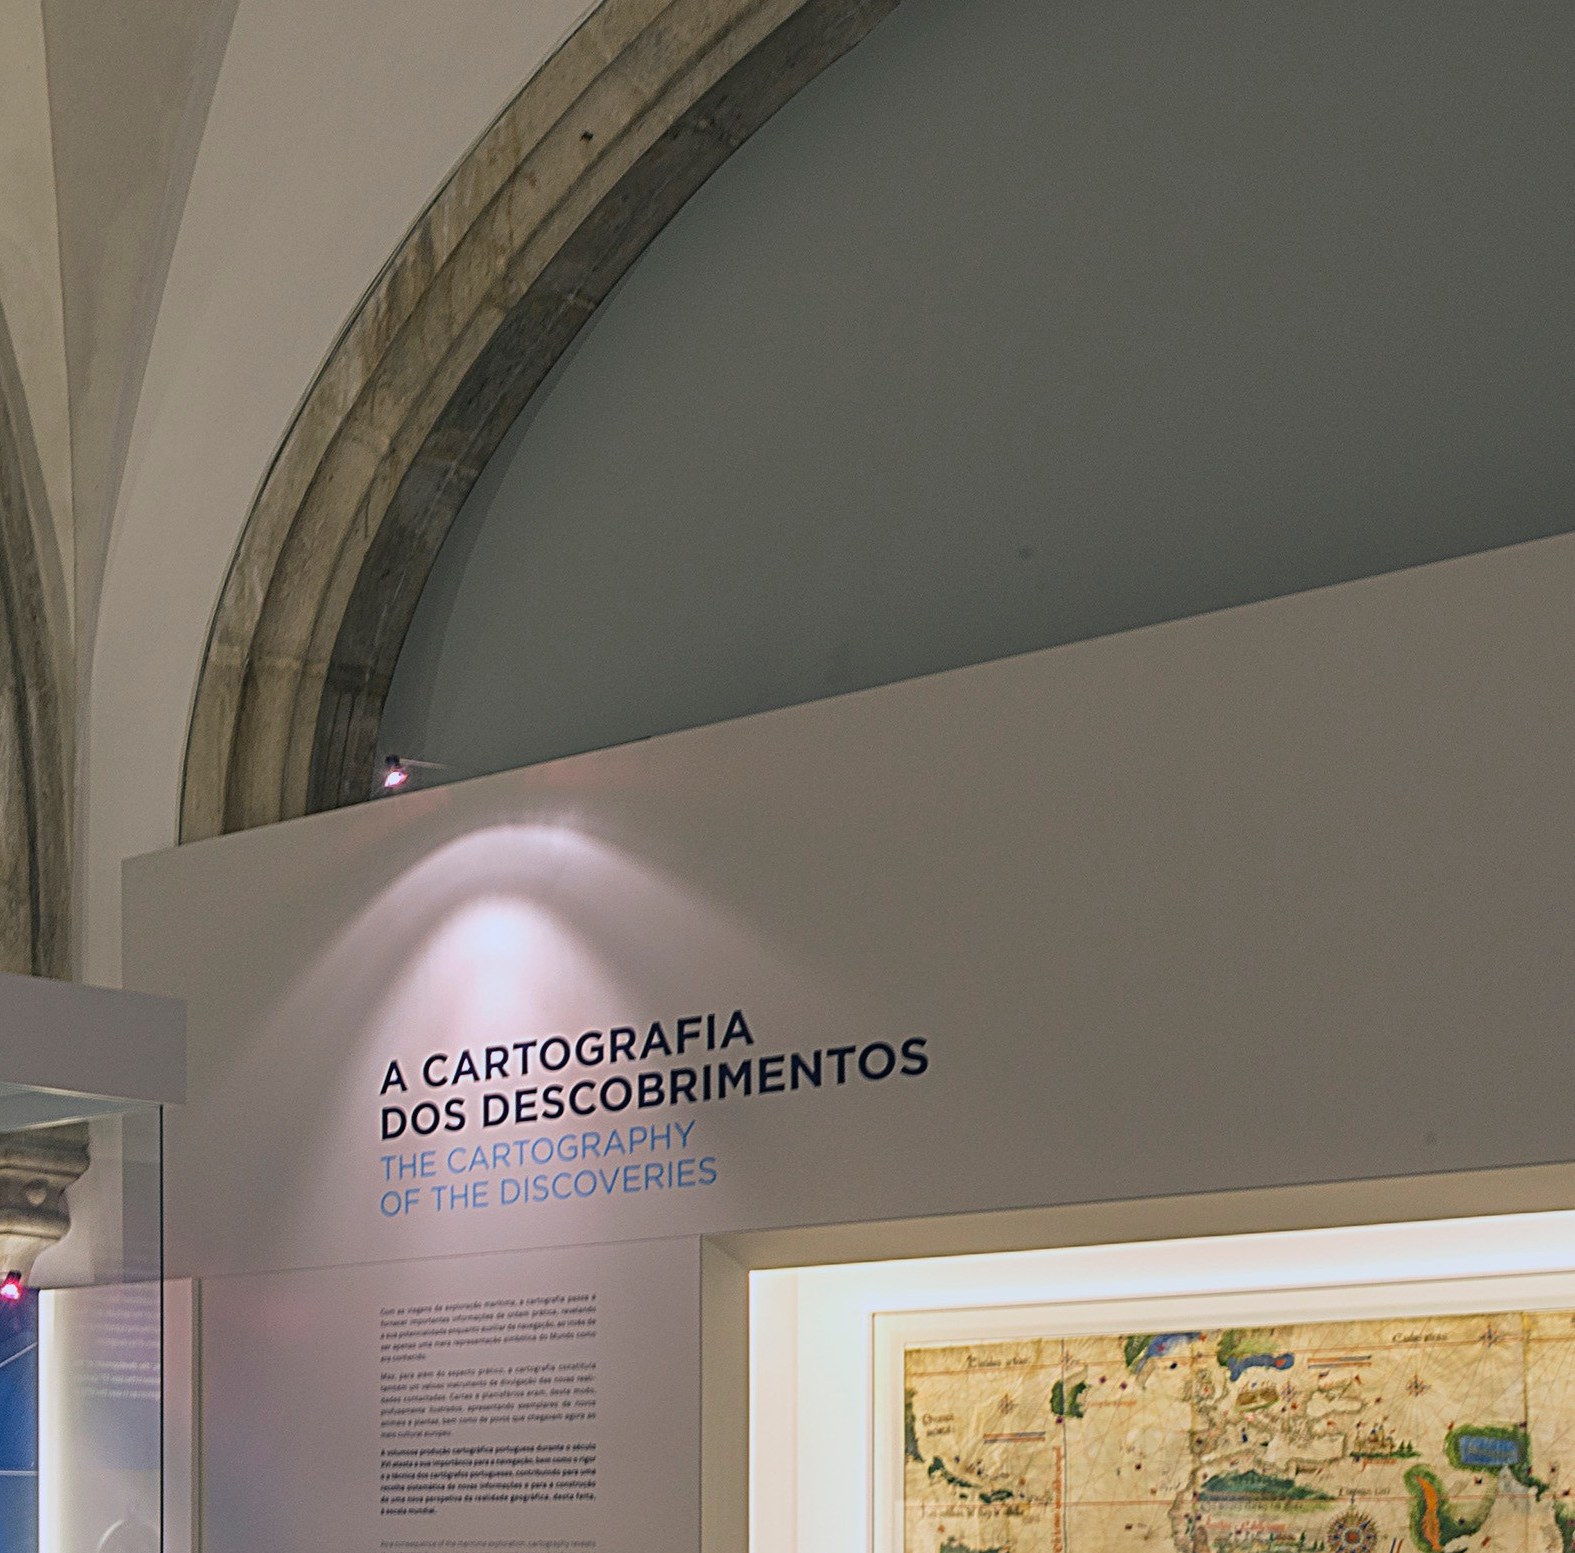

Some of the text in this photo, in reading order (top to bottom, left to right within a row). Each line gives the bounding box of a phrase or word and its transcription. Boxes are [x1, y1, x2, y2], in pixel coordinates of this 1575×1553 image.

[380, 1009, 754, 1095] A CARTOGRAFIA
[381, 1037, 929, 1139] DOS DESCOBRIMENTOS
[380, 1121, 697, 1183] THE CARTOGRAPHY
[380, 1157, 718, 1218] OF THE DISCOVERIES
